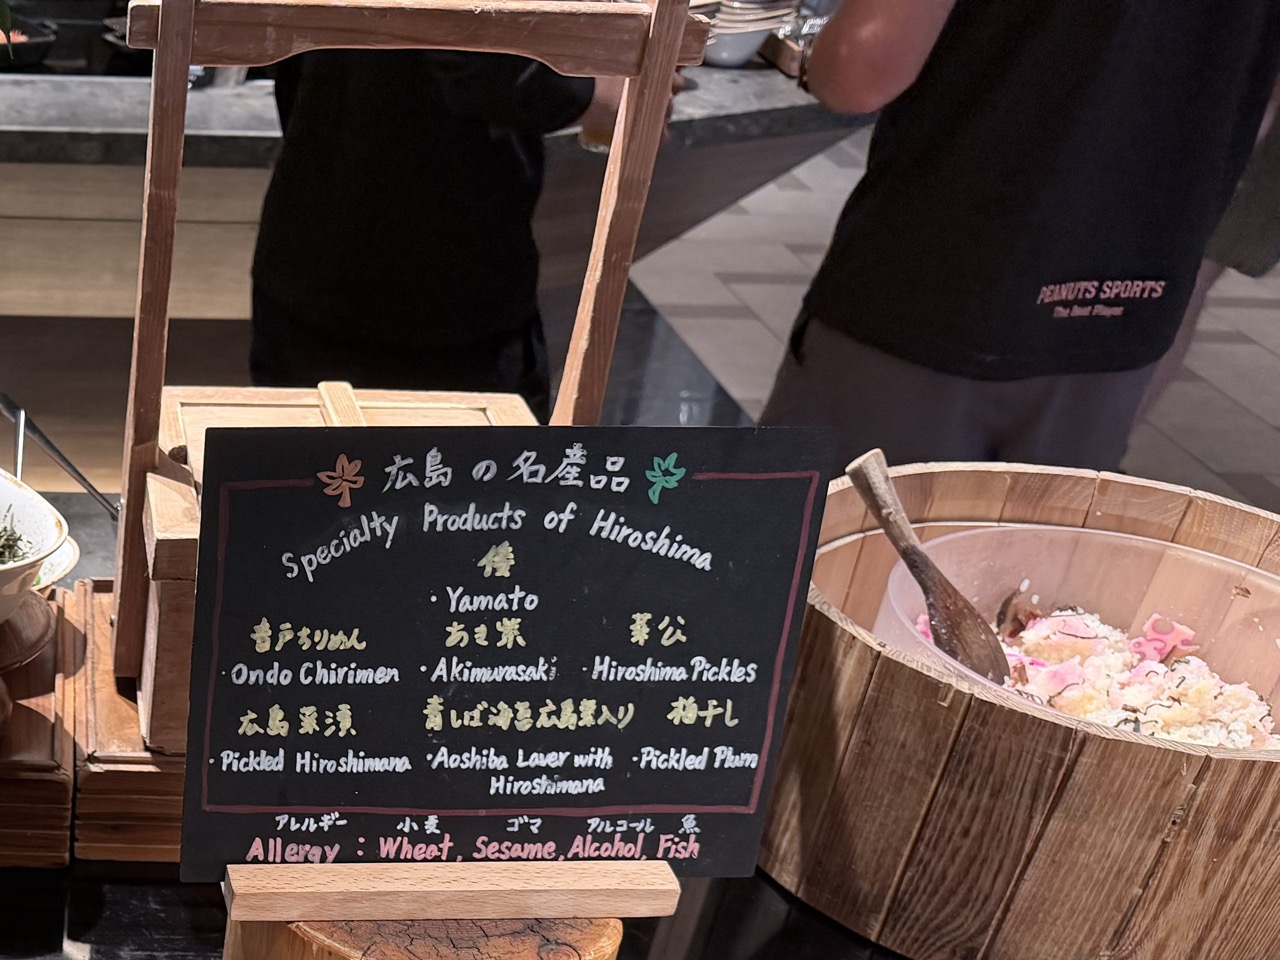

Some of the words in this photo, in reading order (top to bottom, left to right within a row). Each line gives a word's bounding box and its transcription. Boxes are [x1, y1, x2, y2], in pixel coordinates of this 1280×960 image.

[1036, 281, 1099, 305] PEANUTS
[1100, 280, 1166, 299] SPORTS
[282, 511, 398, 583] Specialty
[422, 502, 526, 532] Products
[543, 502, 577, 533] of
[589, 509, 712, 572] Hiroshima
[446, 585, 539, 613] Yamato
[231, 661, 293, 685] Ondo
[299, 661, 400, 685] Chirimen
[591, 655, 687, 682] Hiroshima
[690, 655, 758, 683] Pickles
[220, 748, 285, 773] Pickled
[295, 749, 413, 774] Hiroshimana
[431, 746, 509, 771] Aoshiba
[573, 746, 614, 770] with
[639, 746, 710, 771] Pickled
[713, 745, 759, 770] Plum
[245, 836, 341, 864] Allergy
[655, 834, 700, 860] Fish
